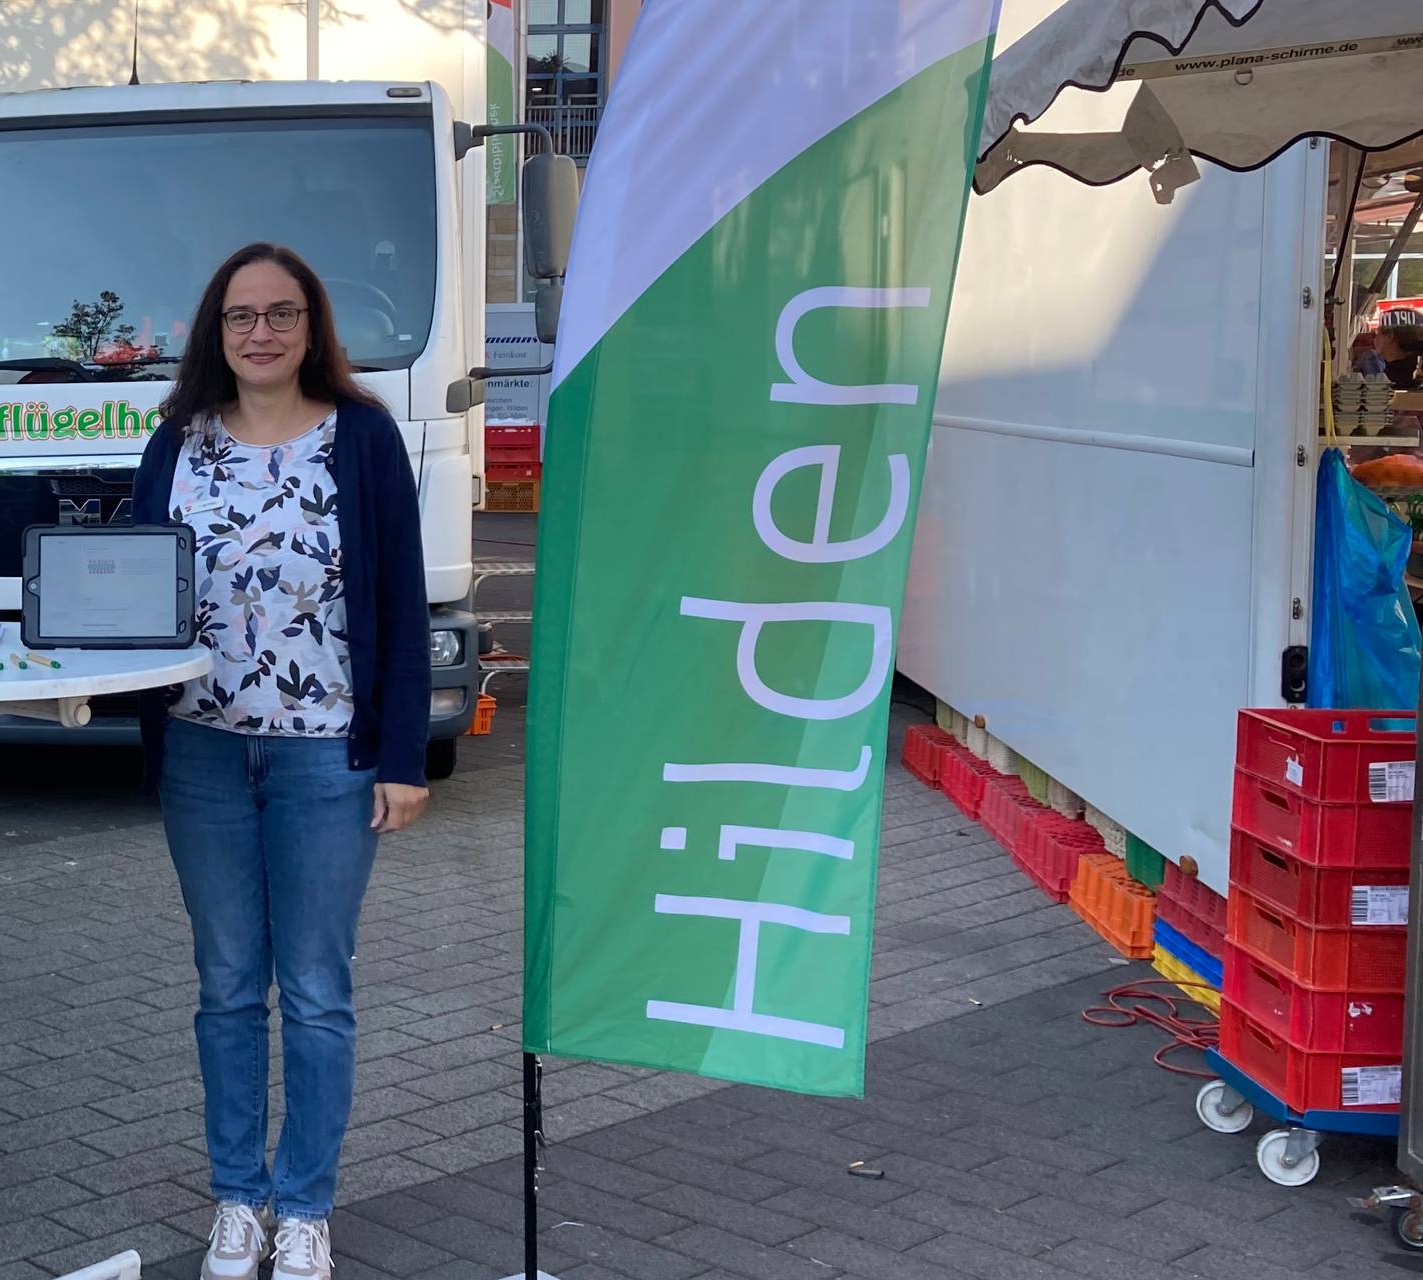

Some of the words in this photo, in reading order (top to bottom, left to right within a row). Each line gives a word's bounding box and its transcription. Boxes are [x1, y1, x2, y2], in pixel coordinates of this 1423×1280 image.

[1396, 35, 1423, 47] ww
[1174, 41, 1359, 71] www.plana-schirme.de
[1118, 66, 1136, 77] de
[493, 350, 527, 359] Feinkost
[486, 378, 534, 388] nmärkte:
[59, 498, 134, 527] MA
[646, 286, 932, 1049] Hilden
